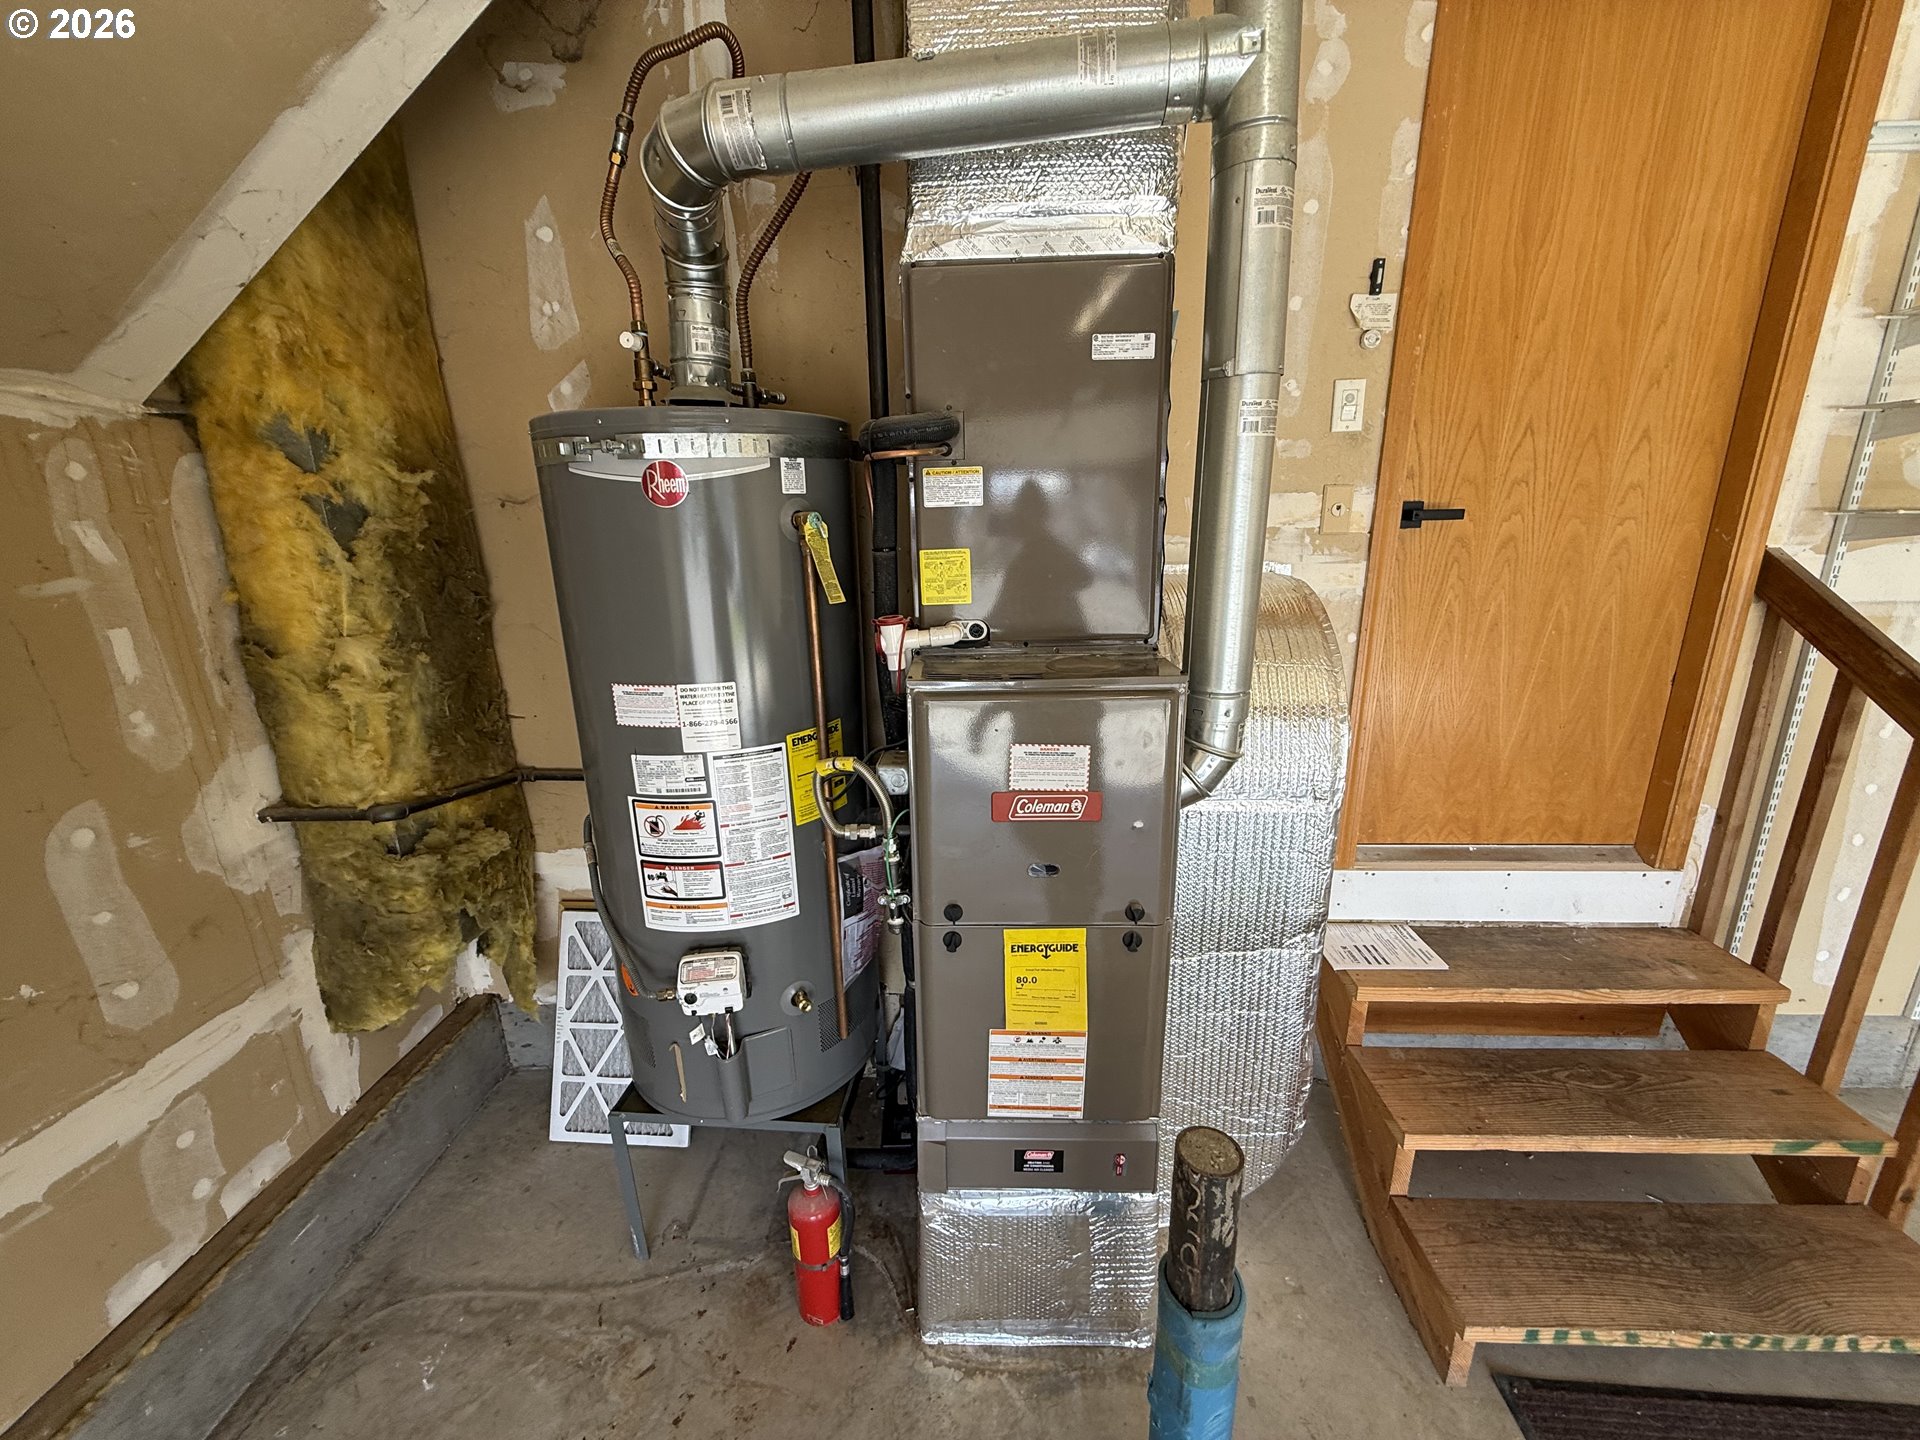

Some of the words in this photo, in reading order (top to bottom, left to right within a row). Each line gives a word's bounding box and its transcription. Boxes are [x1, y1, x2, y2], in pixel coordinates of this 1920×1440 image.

[645, 460, 686, 500] Rheem
[682, 718, 738, 728] 1-866-279-4566
[1016, 798, 1070, 814] Coleman
[1010, 943, 1079, 956] ENERGYGUIDE
[1015, 976, 1038, 984] 80.0
